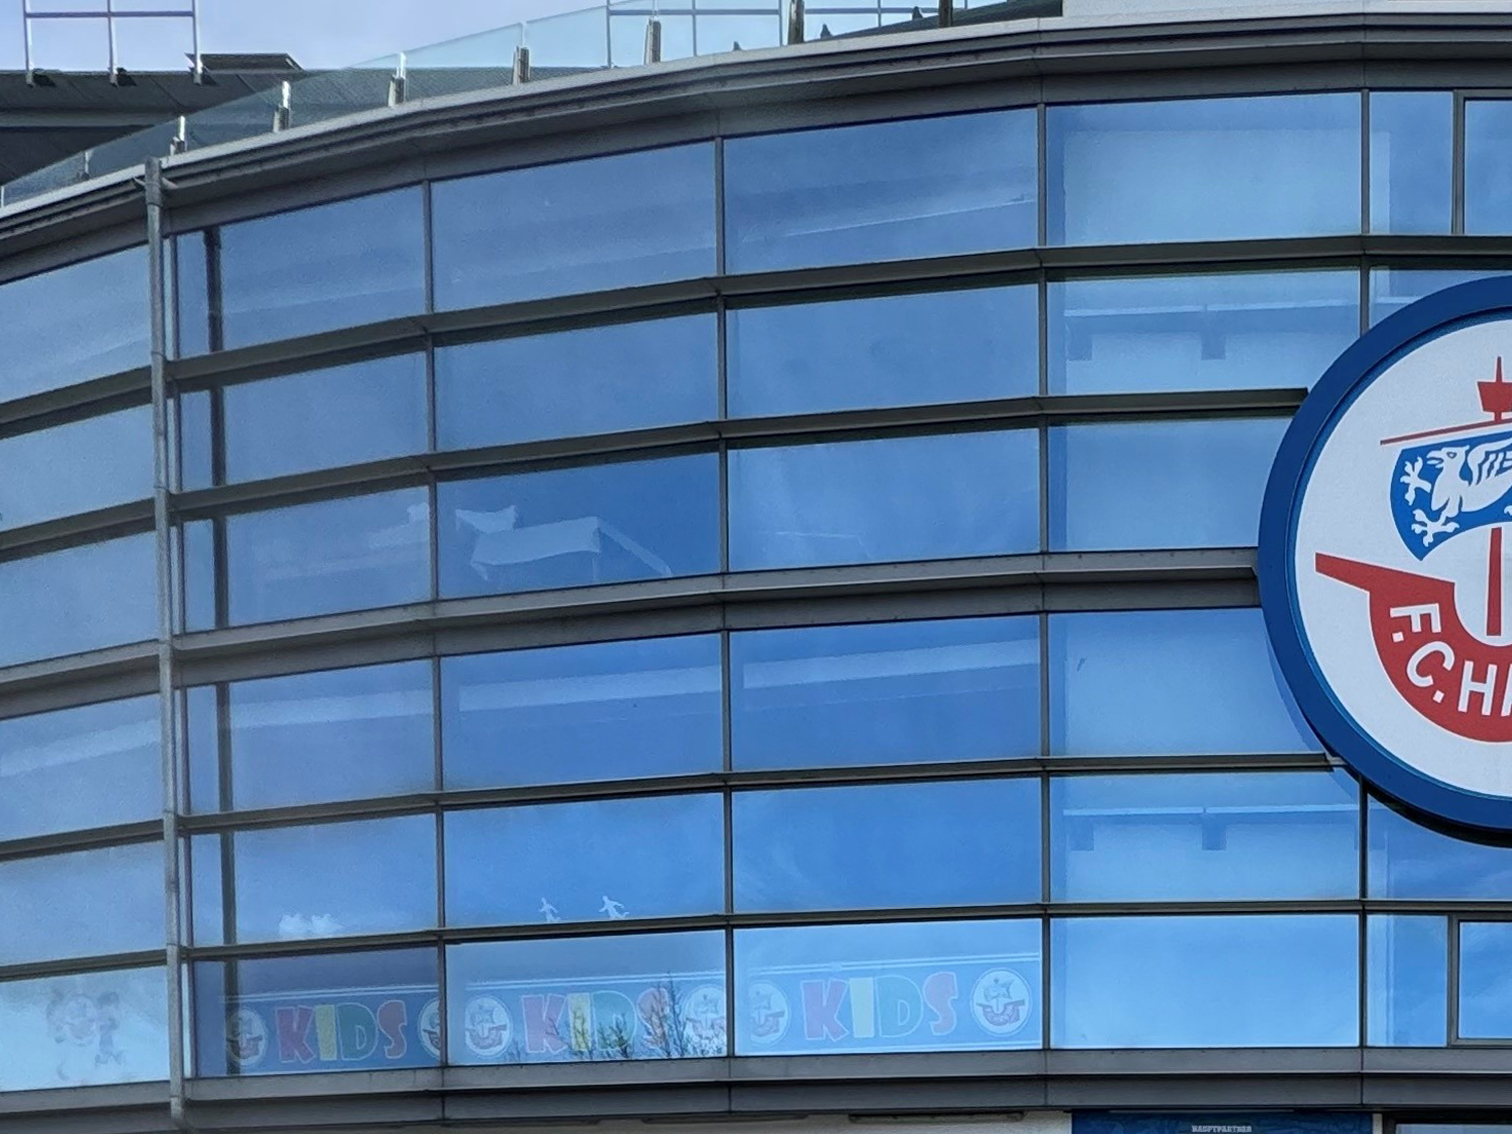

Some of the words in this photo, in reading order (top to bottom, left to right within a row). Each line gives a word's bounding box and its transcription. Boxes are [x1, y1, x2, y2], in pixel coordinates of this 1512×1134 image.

[274, 999, 408, 1064] KIDS
[520, 987, 671, 1055] KIDS
[801, 971, 958, 1043] KIDS
